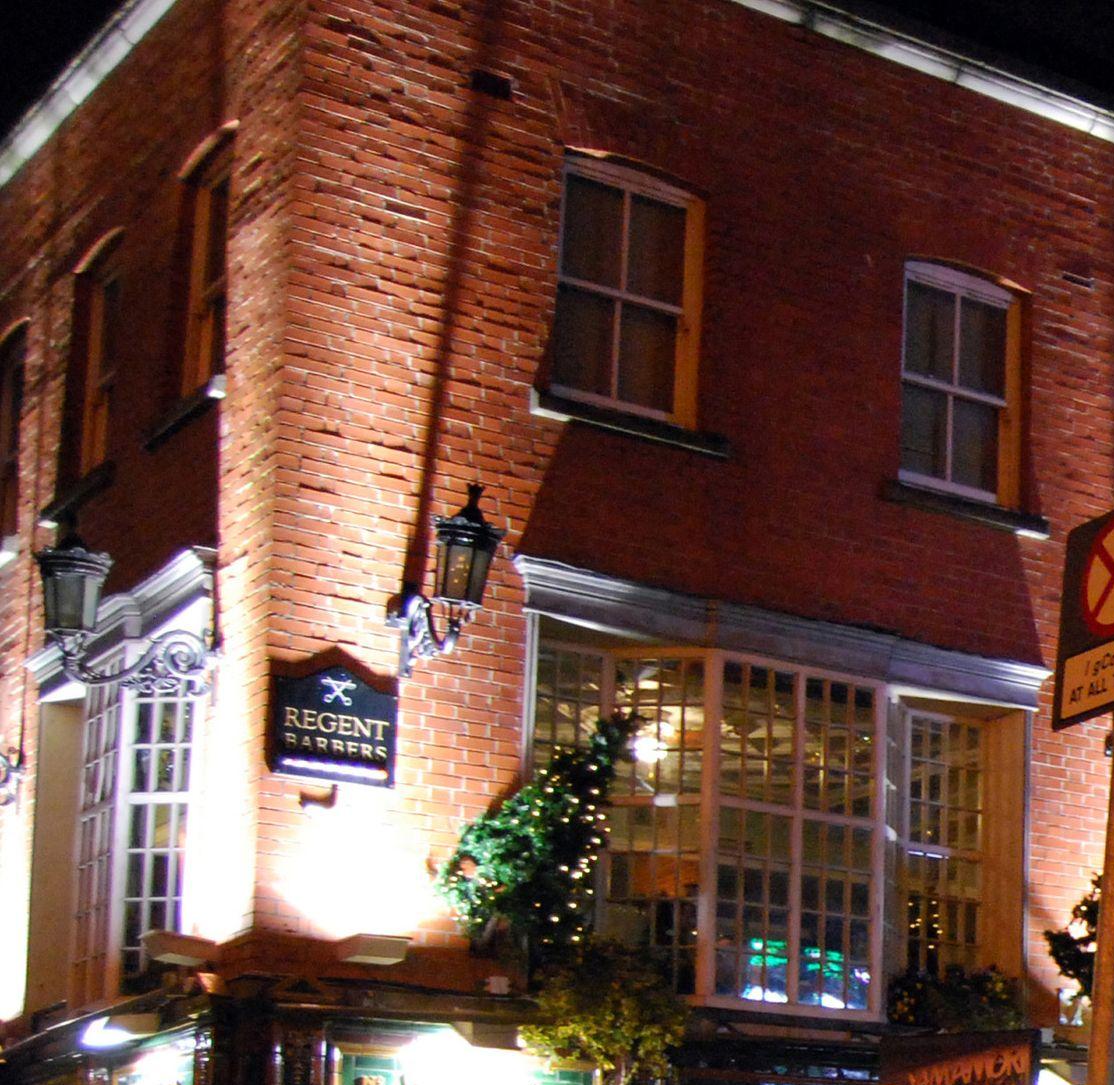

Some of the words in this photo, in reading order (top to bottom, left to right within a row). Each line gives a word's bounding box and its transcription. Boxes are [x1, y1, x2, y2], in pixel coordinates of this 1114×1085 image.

[1069, 685, 1084, 704] AT
[1088, 678, 1108, 697] ALL
[283, 706, 390, 741] REGENT
[283, 732, 388, 759] BARBERS
